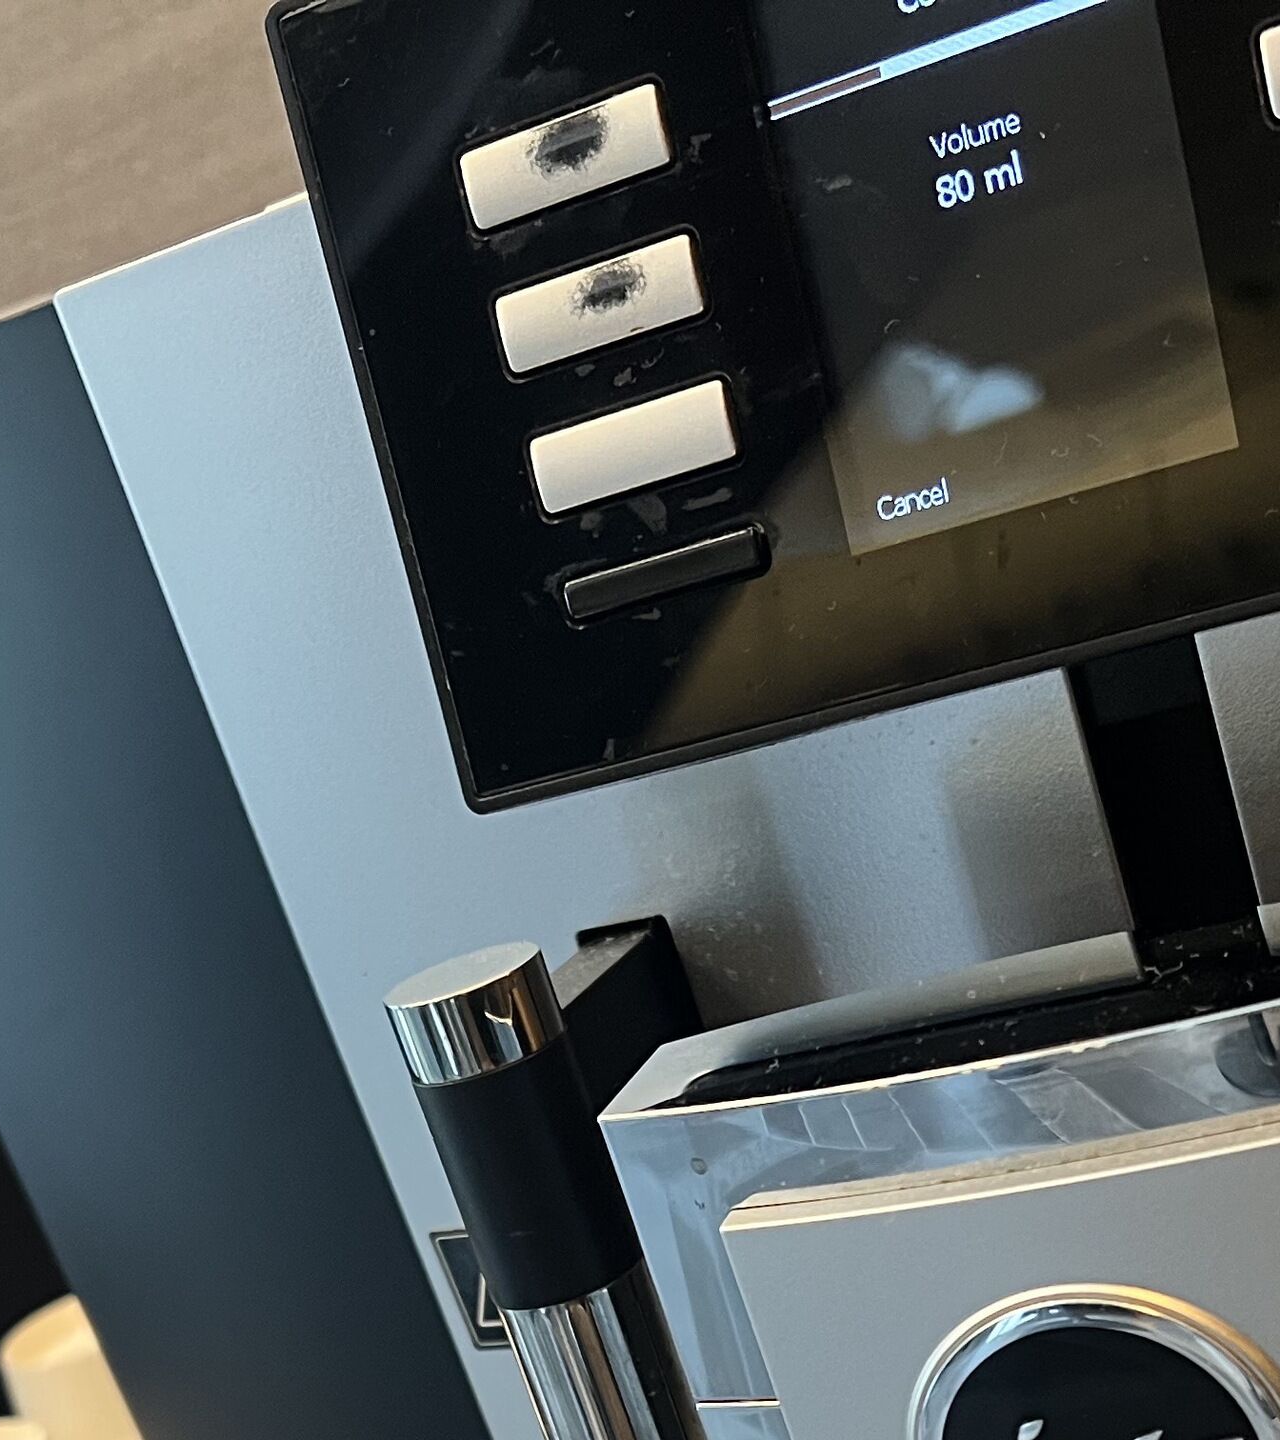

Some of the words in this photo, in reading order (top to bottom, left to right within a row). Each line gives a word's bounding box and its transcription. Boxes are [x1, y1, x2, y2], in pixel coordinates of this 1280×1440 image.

[929, 111, 1021, 159] Volume
[935, 168, 975, 209] 80
[983, 150, 1024, 194] ml
[876, 477, 950, 521] Cancel
